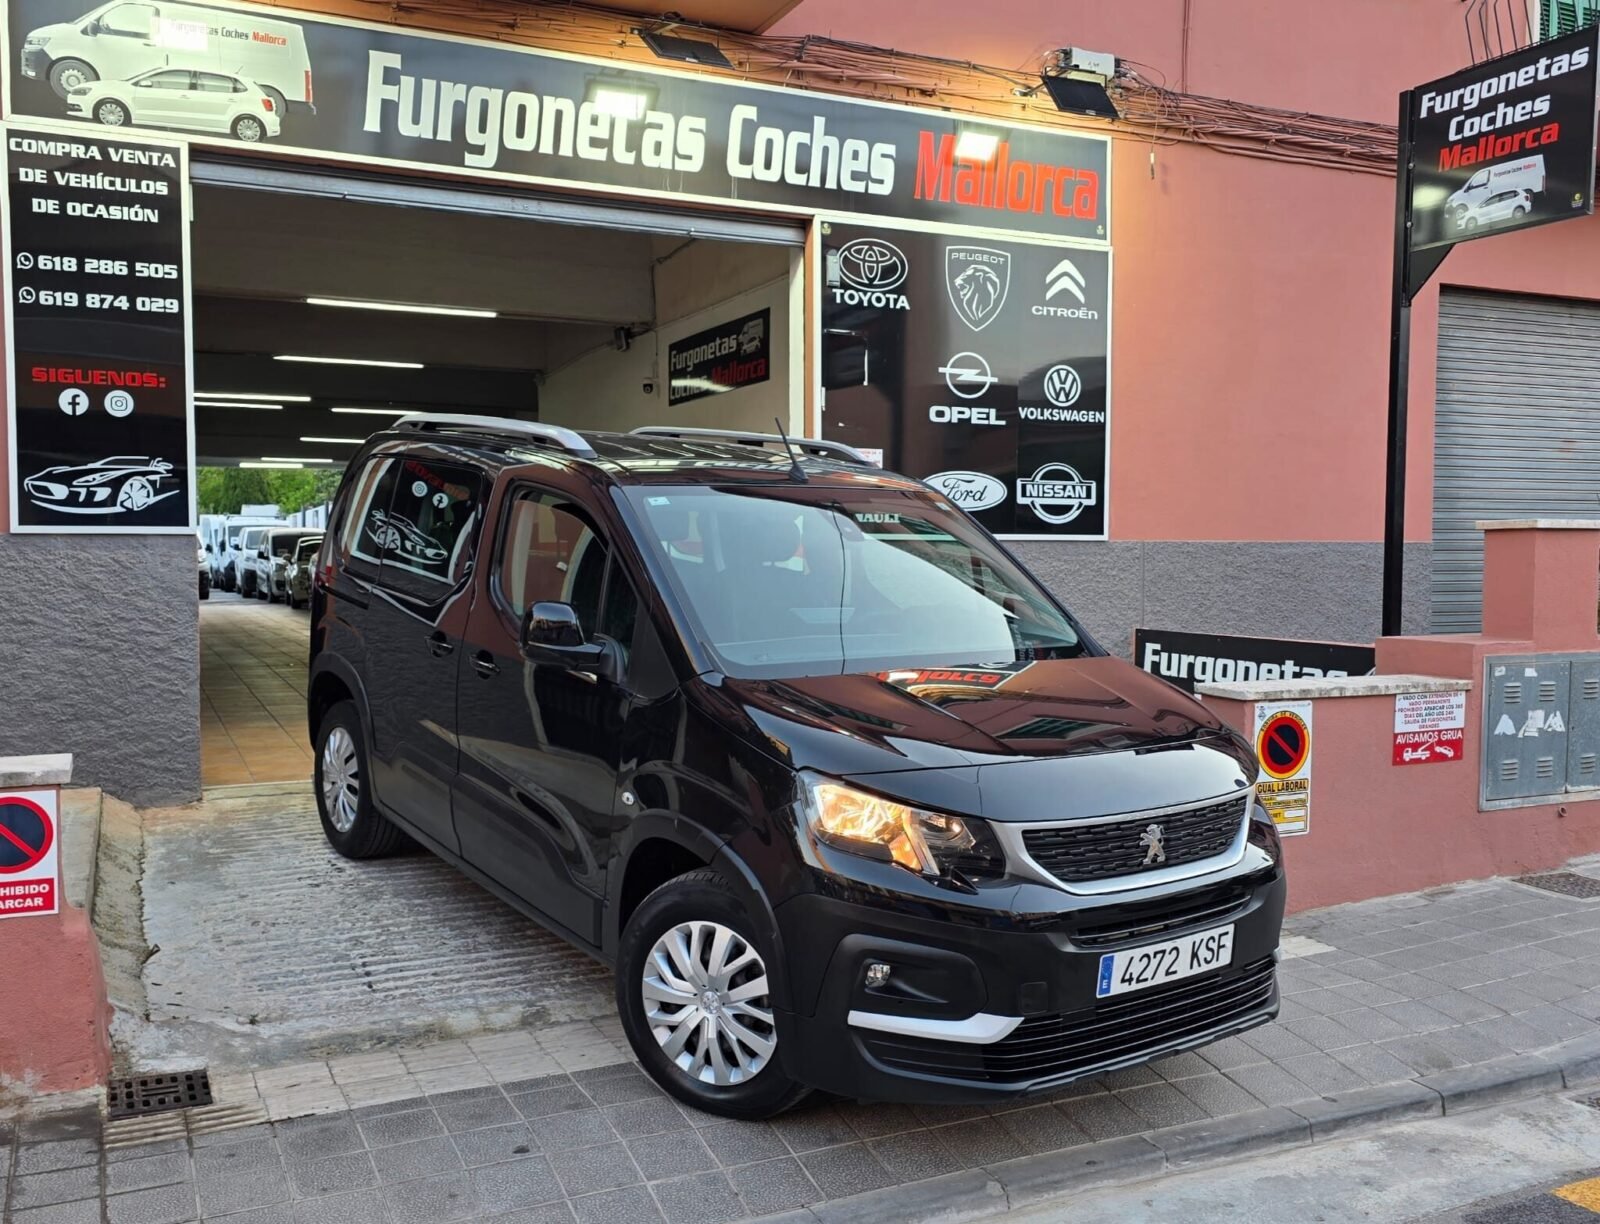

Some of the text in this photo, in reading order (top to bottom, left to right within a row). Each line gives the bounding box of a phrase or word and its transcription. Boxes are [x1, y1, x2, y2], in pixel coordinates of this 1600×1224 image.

[221, 27, 249, 40] Coches
[251, 31, 287, 46] Mallorca
[1420, 46, 1590, 119] Furgonetas
[1448, 94, 1551, 142] Coches
[363, 49, 1099, 220] Furgonetas Coches Mallorca
[9, 138, 176, 168] COMPRA VENTA
[1438, 122, 1560, 173] Mallorca
[19, 167, 169, 196] DE VEHÍCULOS
[32, 198, 159, 223] DE OCASIÓN
[37, 255, 178, 279] 618 286 505
[951, 252, 1005, 265] PEUGEOT
[39, 290, 179, 313] 619 874 029
[832, 288, 910, 310] TOYOTA
[671, 334, 738, 372] Furgonetas
[31, 366, 166, 388] SIGUENOS:
[711, 358, 767, 385] Mallorca
[929, 405, 1006, 425] OPEL
[1018, 406, 1105, 424] VOLKSWAGEN
[942, 477, 987, 503] Ford
[1026, 484, 1087, 499] NISSAN
[1144, 642, 1348, 683] Furgonet
[1396, 729, 1463, 744] AVISAMOS GRUA
[1277, 780, 1307, 791] LABORAL
[0, 883, 50, 896] HIBIDO
[1120, 946, 1181, 986] 4272
[1189, 931, 1230, 970] KSF
